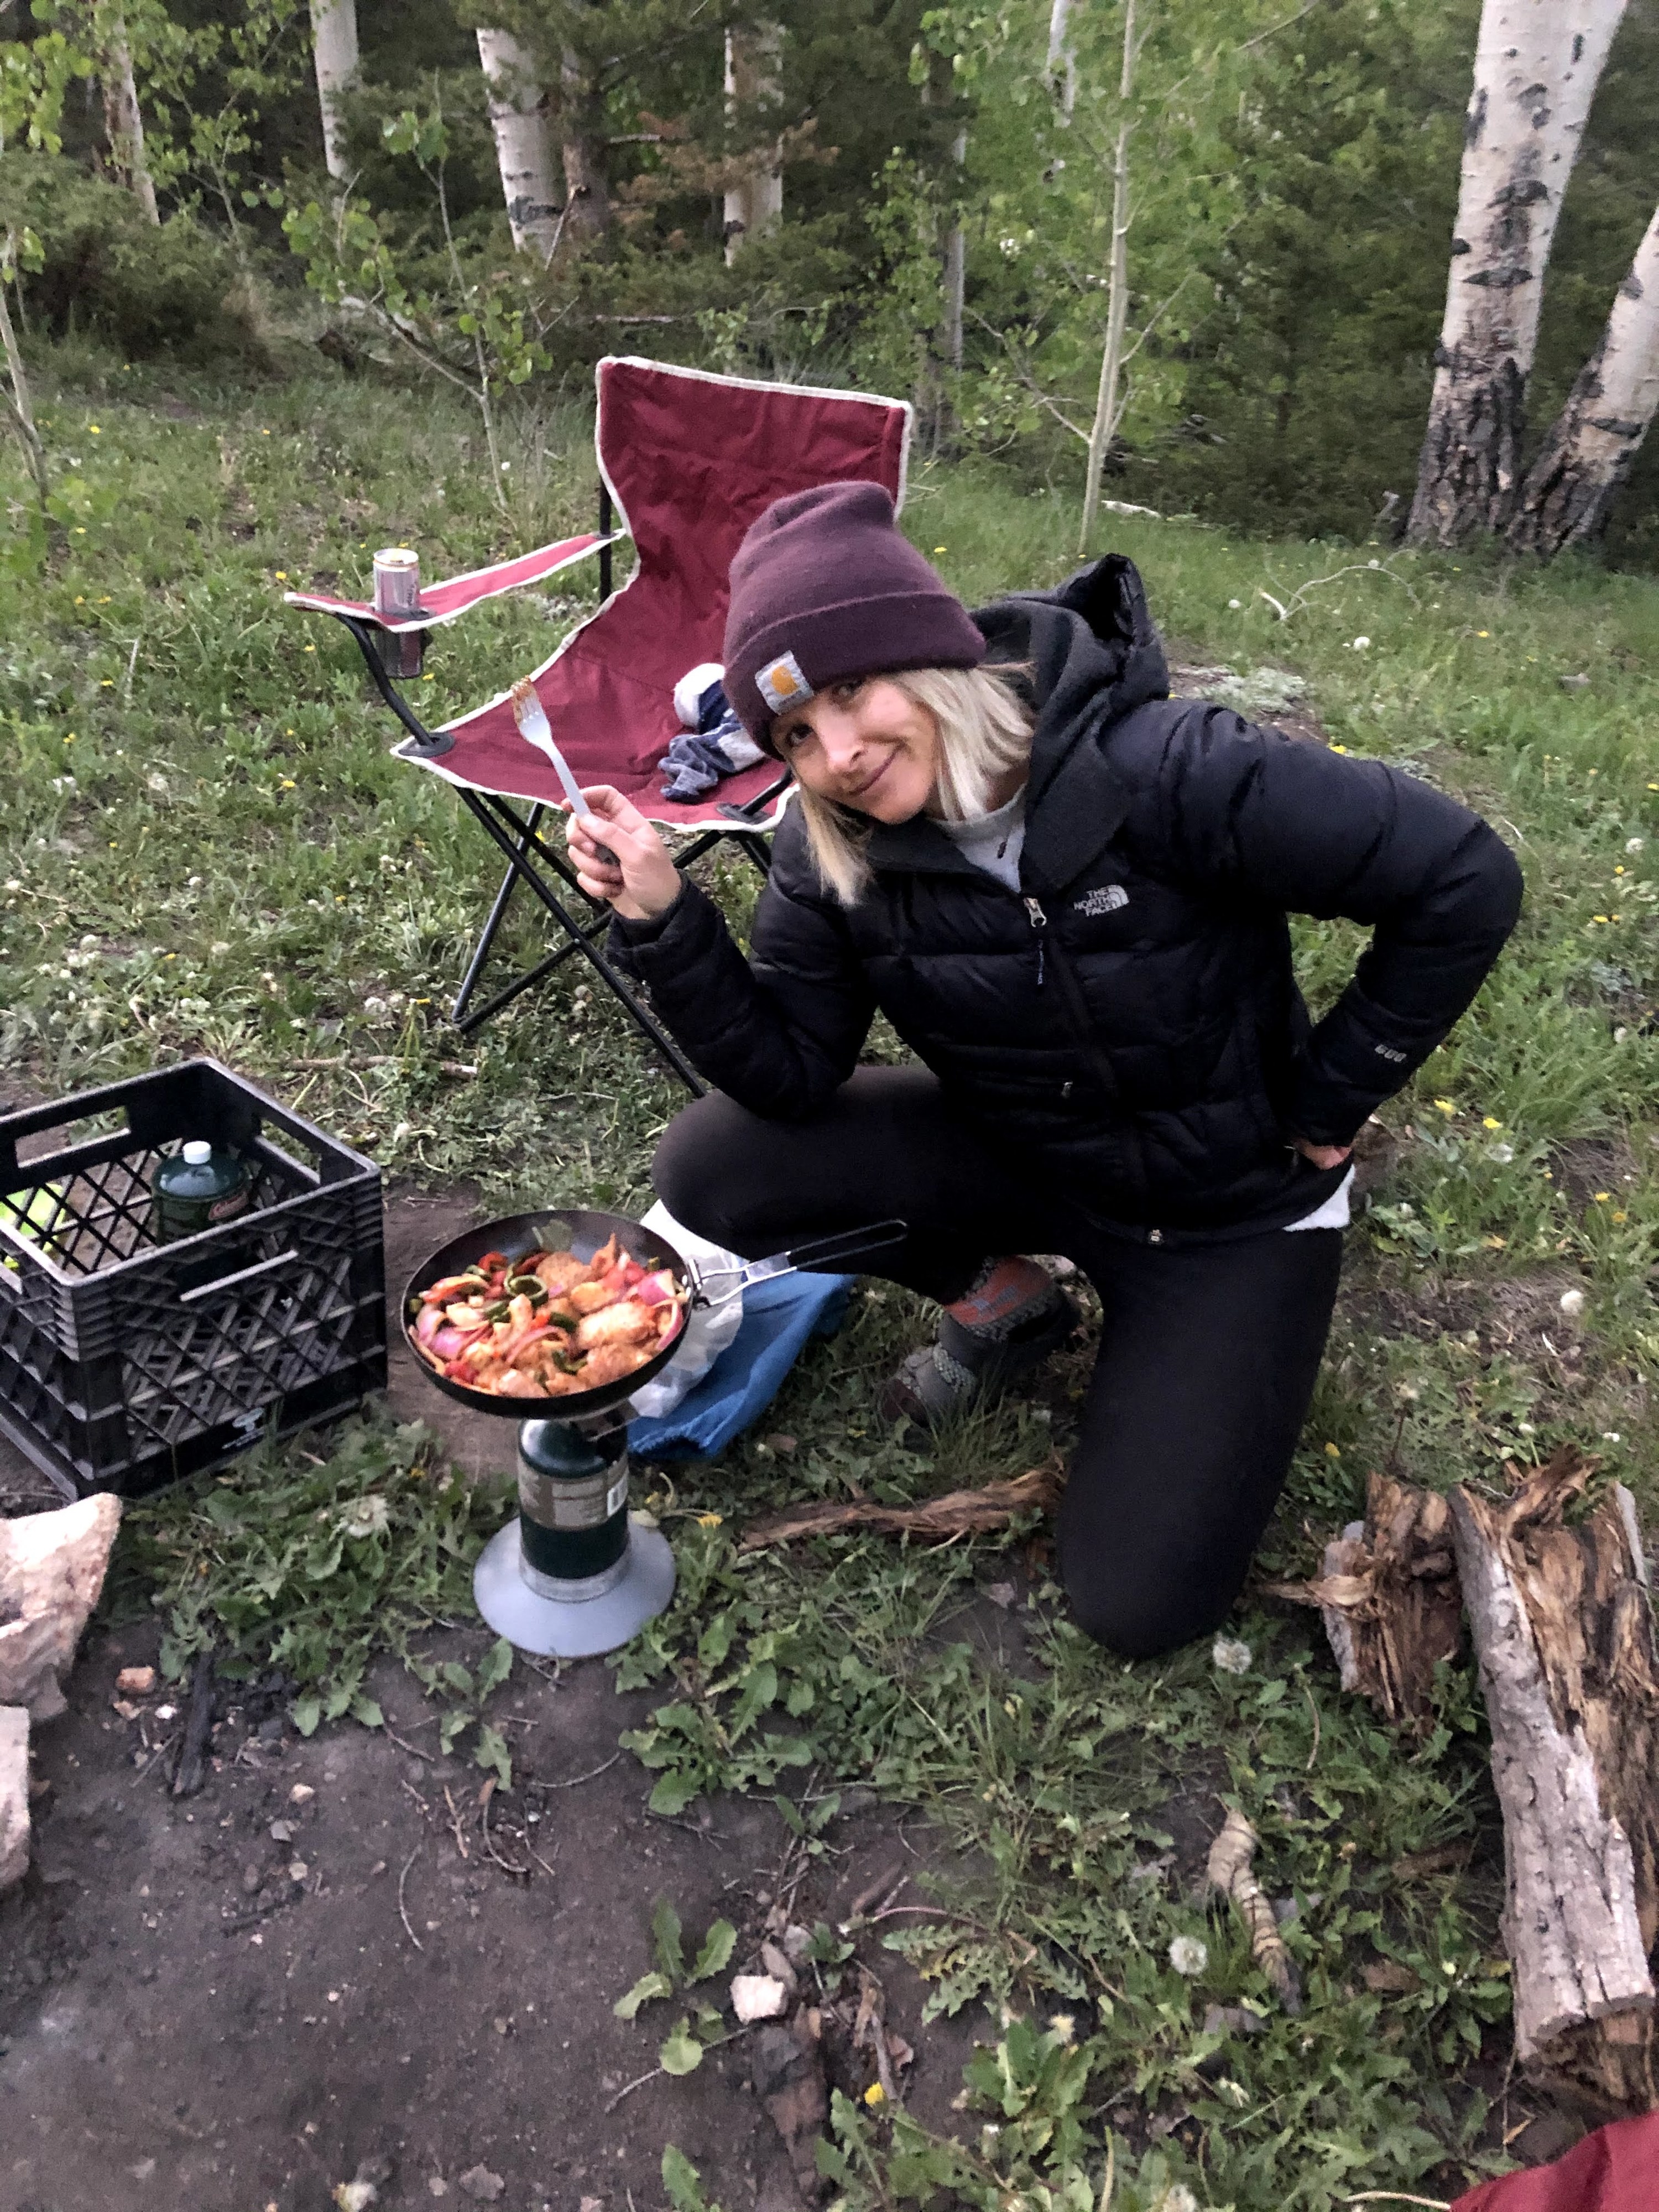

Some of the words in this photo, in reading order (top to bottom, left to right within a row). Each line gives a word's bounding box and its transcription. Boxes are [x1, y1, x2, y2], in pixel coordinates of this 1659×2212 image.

[1086, 886, 1108, 899] THE
[1073, 894, 1111, 911] NORTH
[1086, 905, 1112, 916] FACE
